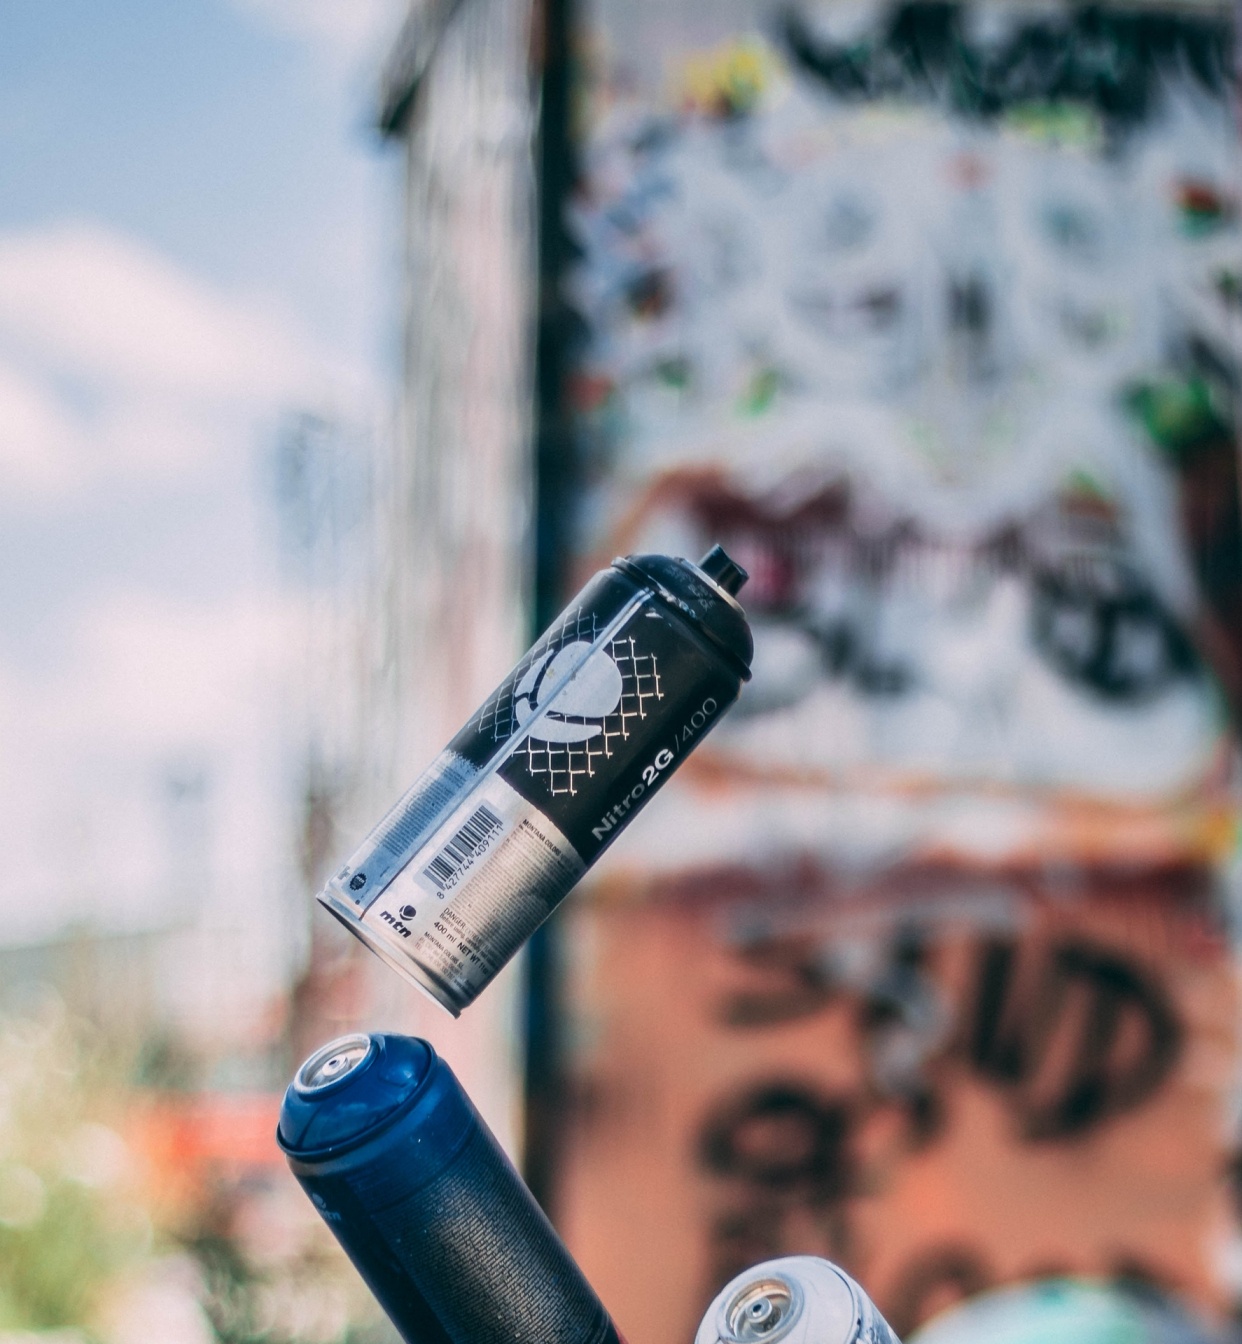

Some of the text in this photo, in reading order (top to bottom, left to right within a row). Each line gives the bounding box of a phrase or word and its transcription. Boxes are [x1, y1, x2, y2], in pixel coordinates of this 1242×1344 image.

[475, 824, 504, 858] 409111
[379, 911, 412, 938] mtn
[431, 919, 448, 935] 400
[445, 932, 457, 944] ml
[455, 941, 472, 957] NET
[468, 953, 481, 965] WT
